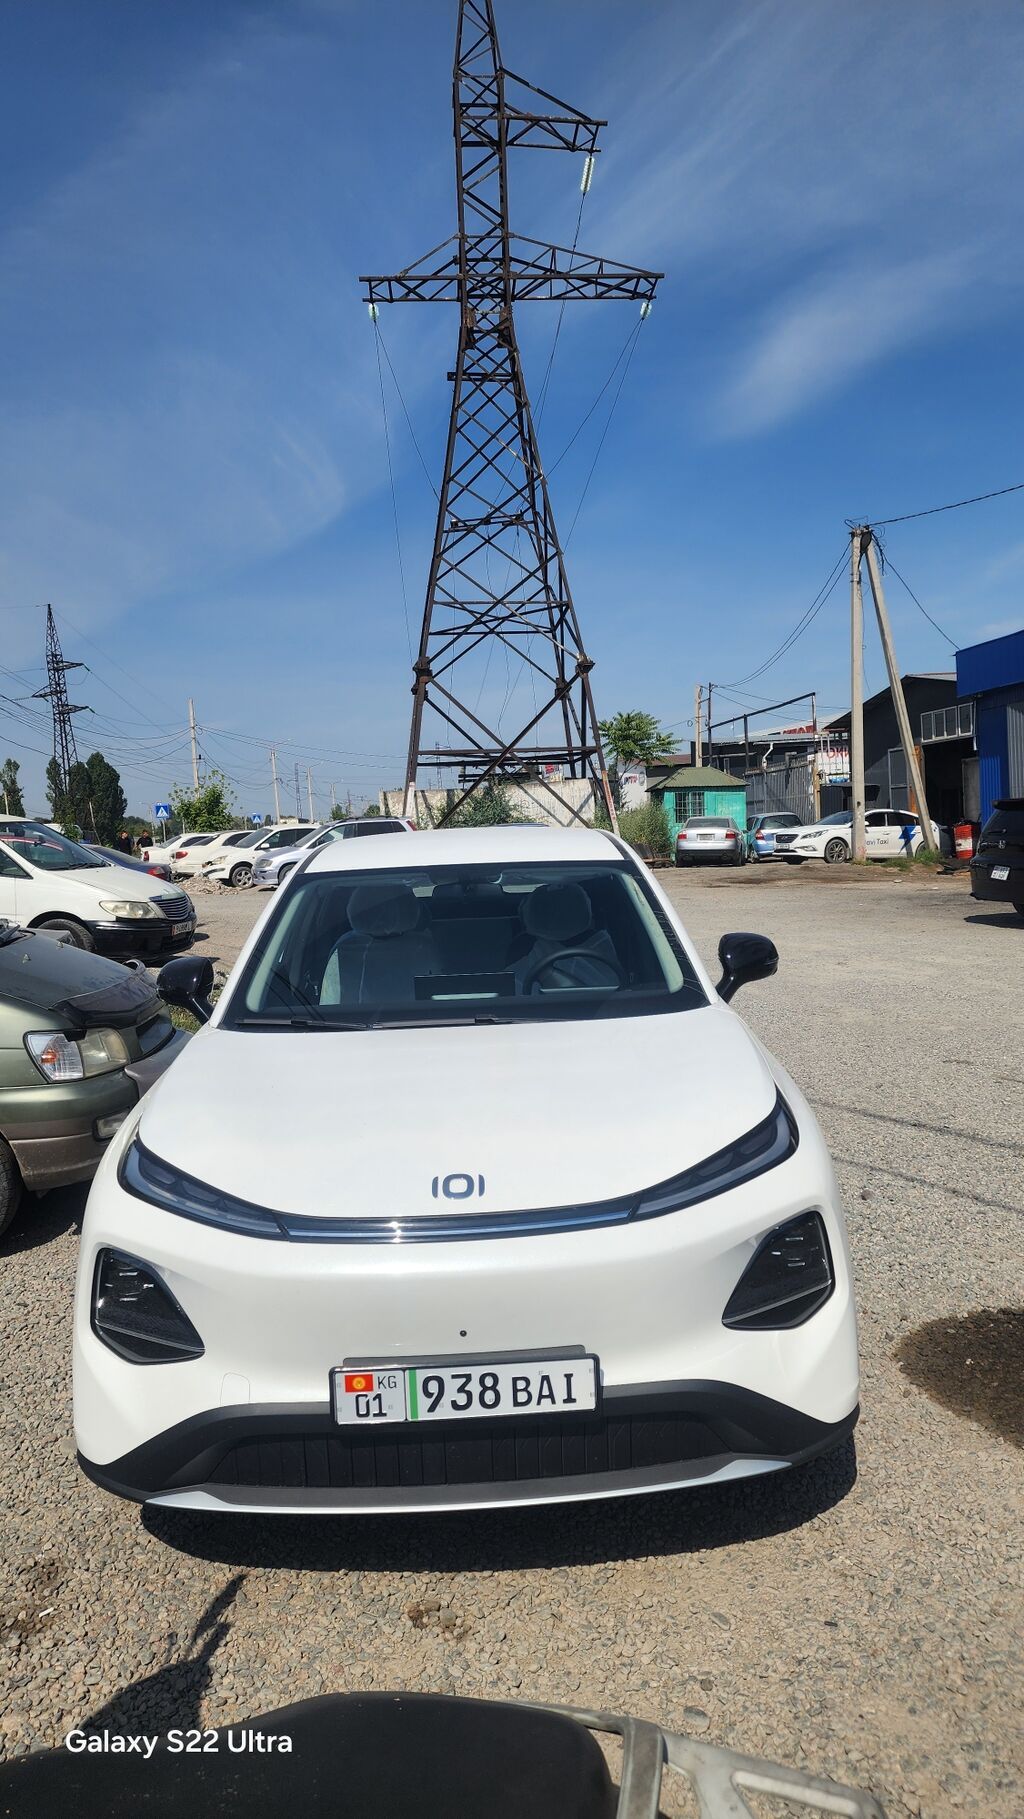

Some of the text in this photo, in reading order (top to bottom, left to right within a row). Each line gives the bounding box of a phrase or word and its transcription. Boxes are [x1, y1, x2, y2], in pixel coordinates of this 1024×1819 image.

[377, 1375, 397, 1389] KG
[421, 1372, 577, 1413] 938 BAI
[355, 1393, 387, 1418] 01
